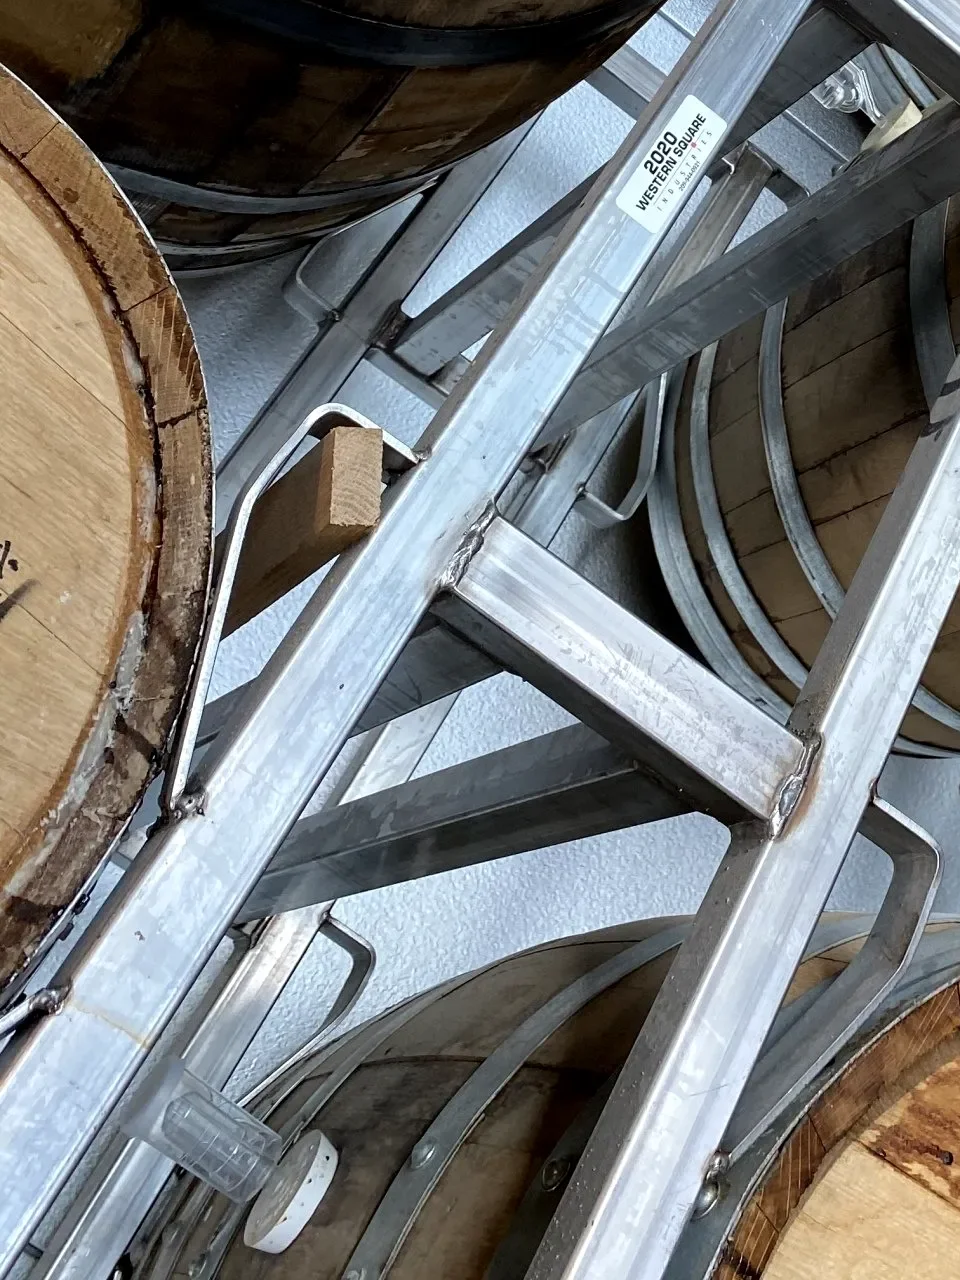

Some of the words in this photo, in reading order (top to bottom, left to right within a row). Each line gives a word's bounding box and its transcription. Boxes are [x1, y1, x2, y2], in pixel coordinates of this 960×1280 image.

[635, 156, 677, 212] WESTERN
[673, 113, 707, 157] SQUARE
[643, 131, 678, 175] 2020
